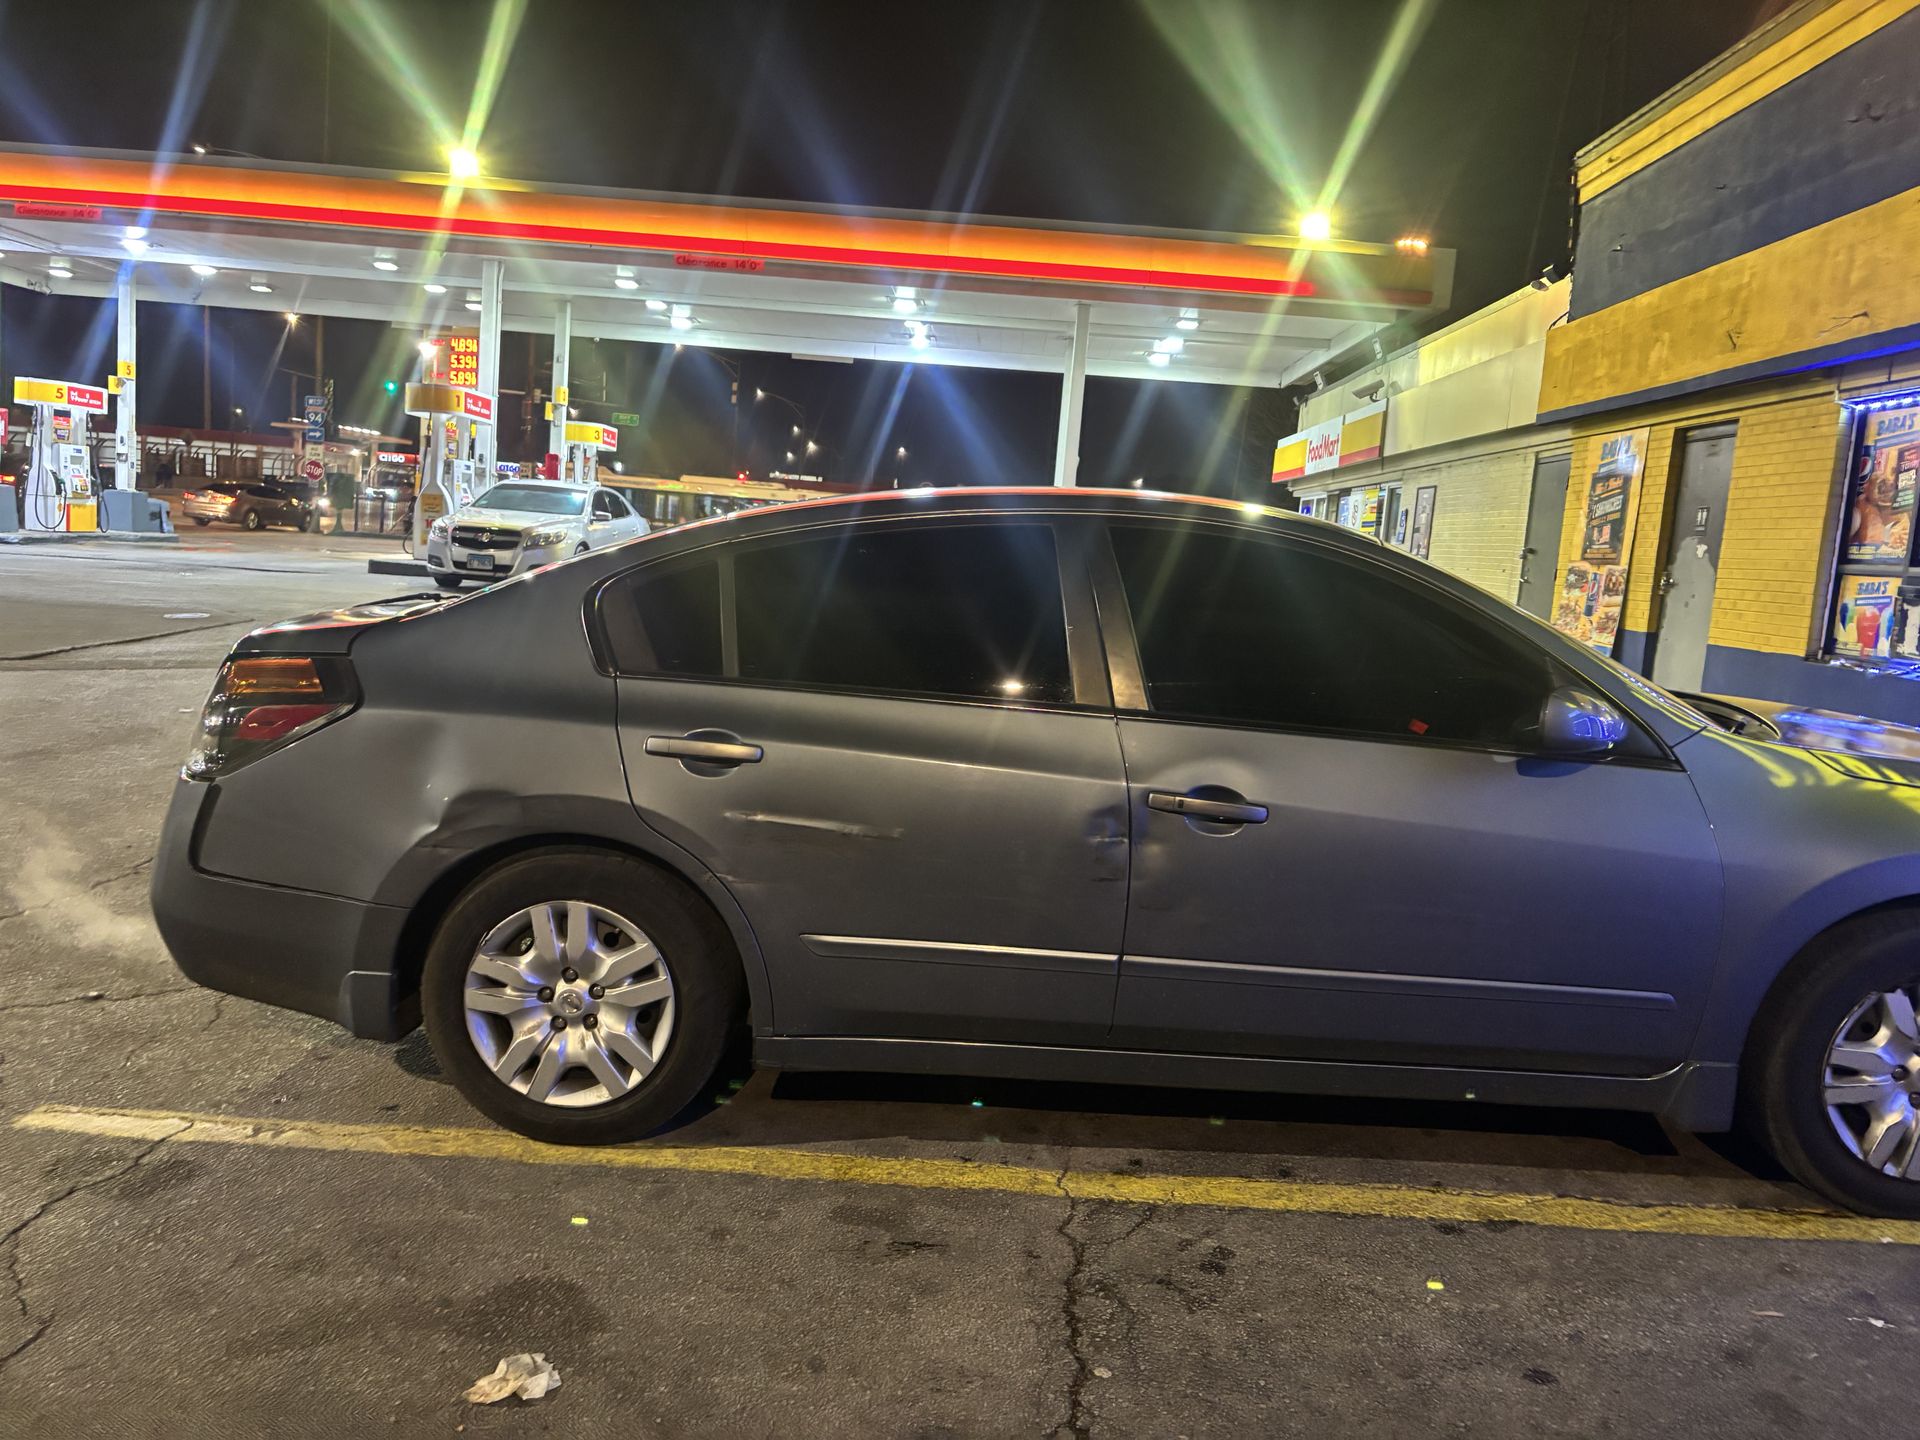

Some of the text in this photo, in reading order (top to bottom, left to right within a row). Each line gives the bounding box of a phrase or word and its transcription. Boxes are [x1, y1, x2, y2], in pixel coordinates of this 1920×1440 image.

[676, 256, 728, 269] Clearance
[126, 365, 132, 376] 5
[55, 387, 64, 399] 5
[455, 394, 460, 408] 1
[308, 412, 322, 423] 94
[594, 430, 600, 441] 3
[1307, 433, 1340, 463] FoodMart
[306, 464, 323, 476] STOP
[1856, 581, 1890, 595] BABA'S
